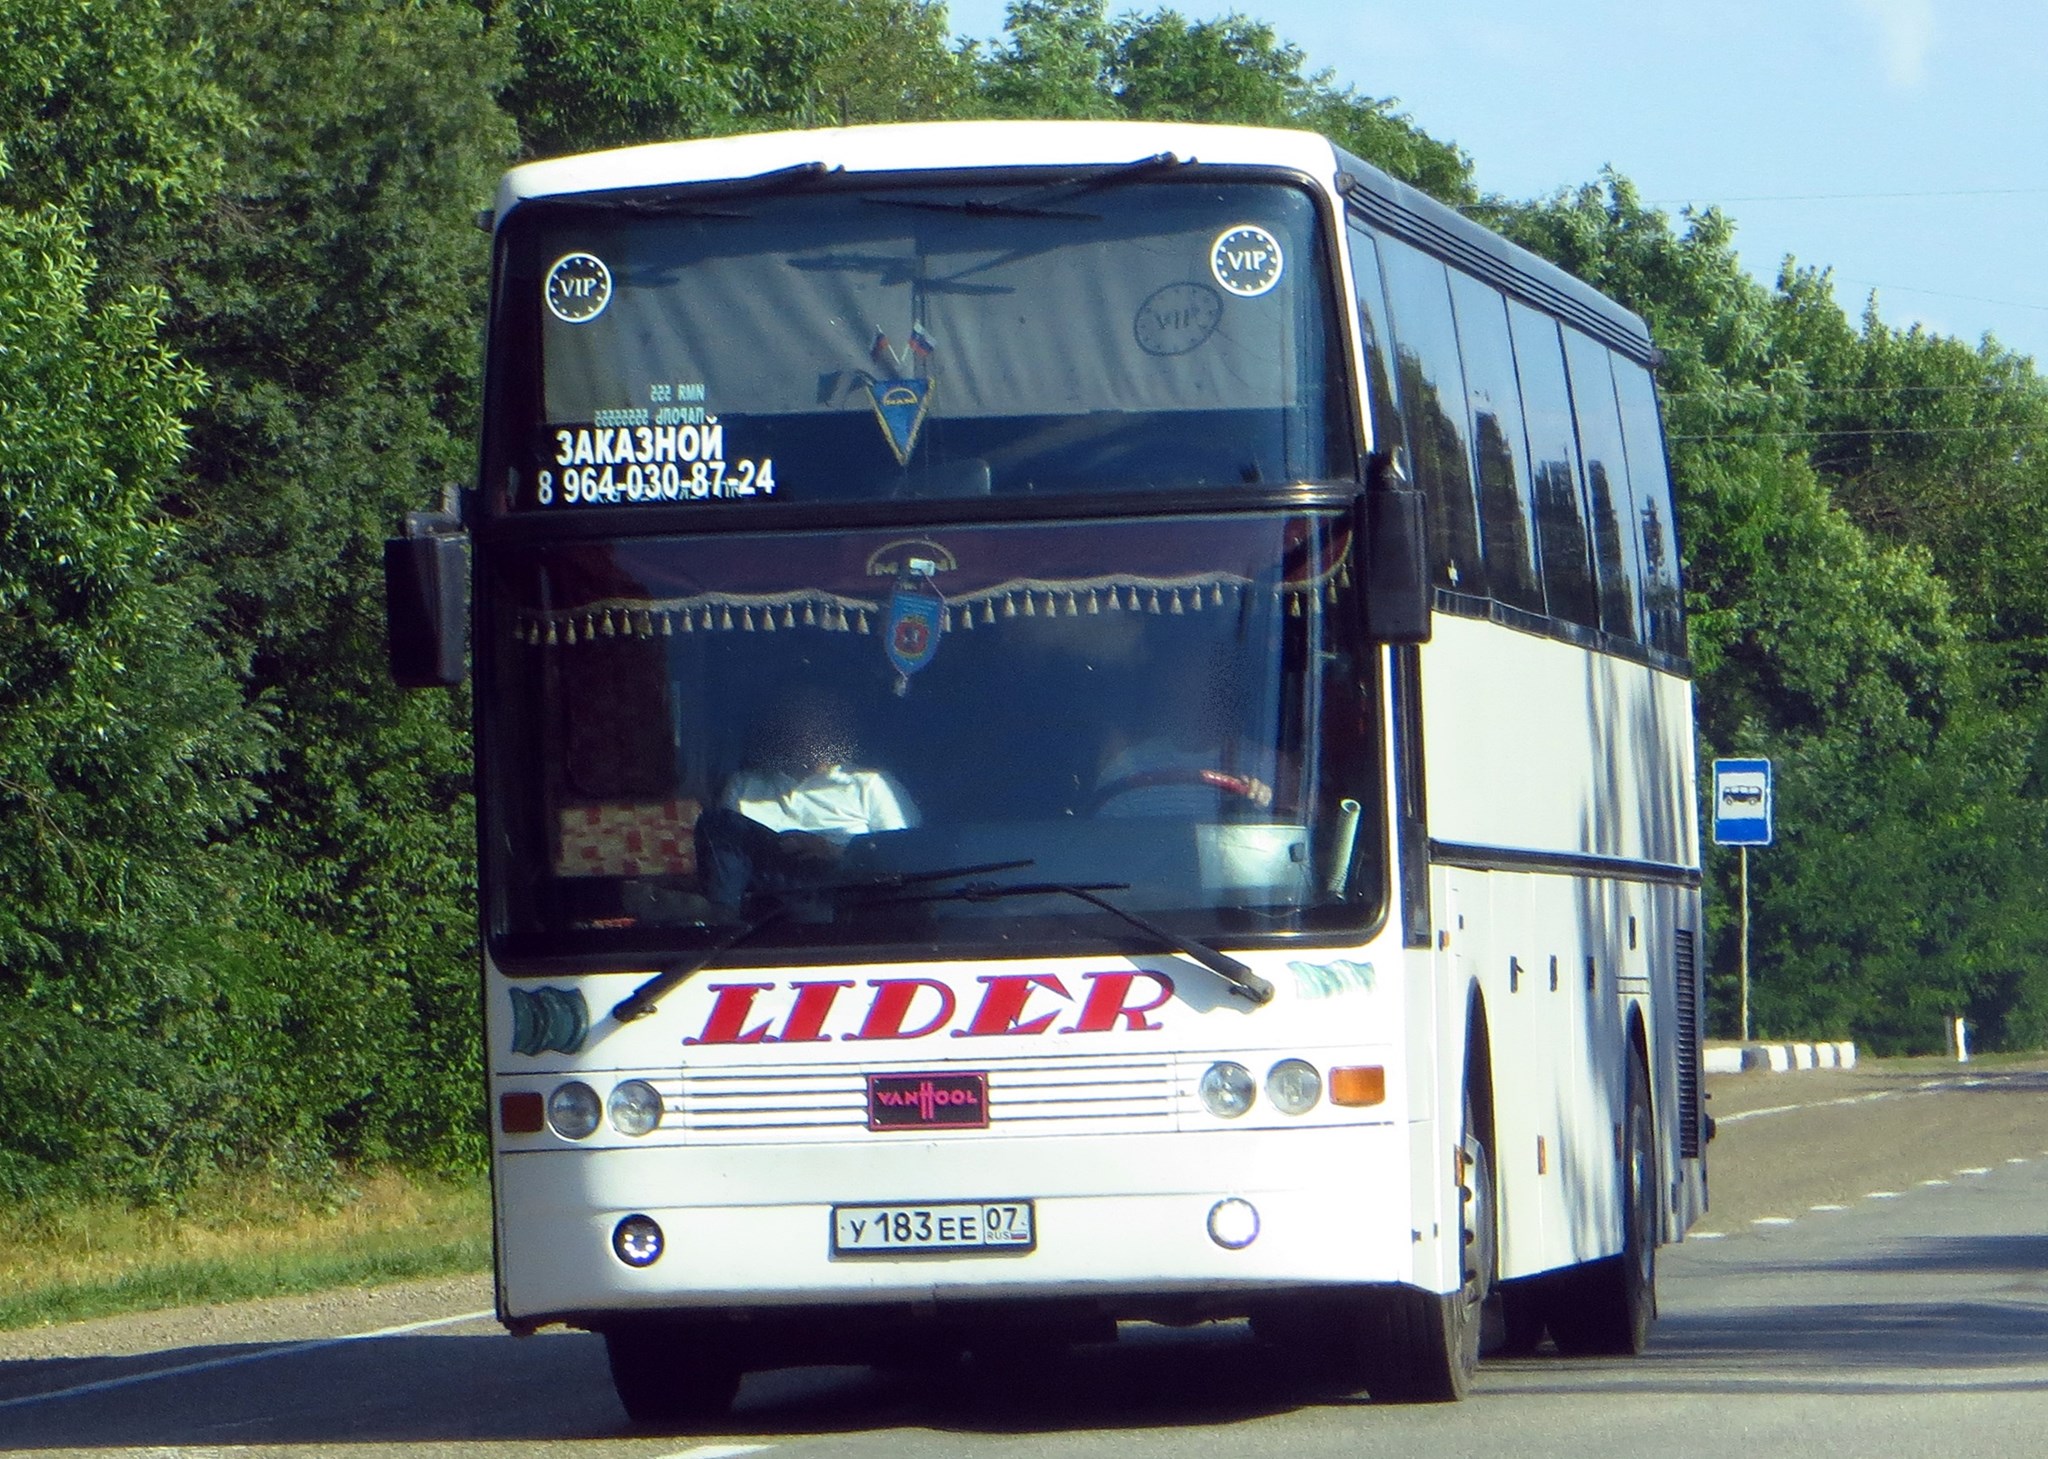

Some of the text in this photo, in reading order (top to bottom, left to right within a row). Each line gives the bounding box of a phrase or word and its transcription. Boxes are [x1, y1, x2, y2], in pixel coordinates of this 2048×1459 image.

[1227, 251, 1267, 271] VIP
[560, 278, 597, 297] VIP
[555, 415, 723, 466] ЗАКАЗНОЙ
[538, 470, 553, 504] 8
[564, 459, 775, 503] 964-030-87-24
[682, 970, 1176, 1046] LIDER
[986, 1207, 1018, 1231] 07
[987, 1231, 1010, 1240] RUS
